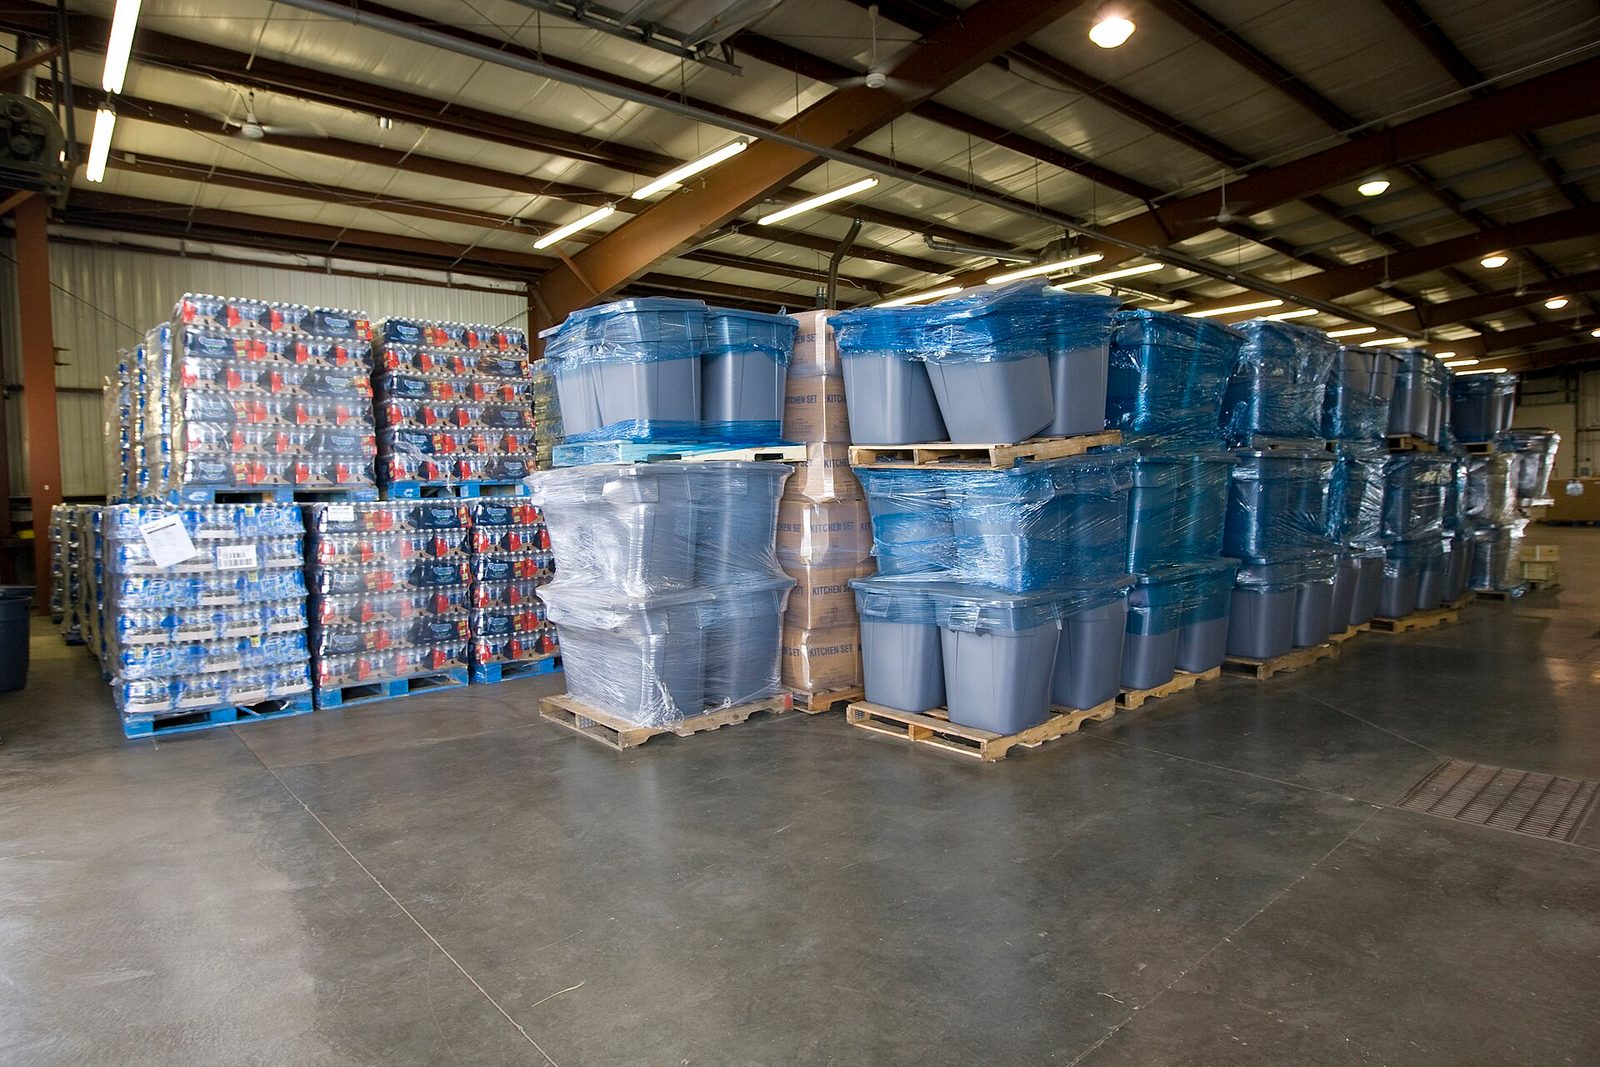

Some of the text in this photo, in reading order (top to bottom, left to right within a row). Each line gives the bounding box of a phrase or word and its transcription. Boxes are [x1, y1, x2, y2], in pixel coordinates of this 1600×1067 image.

[806, 333, 816, 343] SE
[806, 395, 817, 403] SET
[826, 394, 846, 402] KITCH
[824, 459, 849, 468] KITCHE
[810, 523, 841, 533] KITCHEN
[842, 521, 853, 530] SET
[812, 585, 842, 595] KITCHEN
[788, 647, 800, 656] SET
[809, 644, 853, 657] KITCHEN SET
